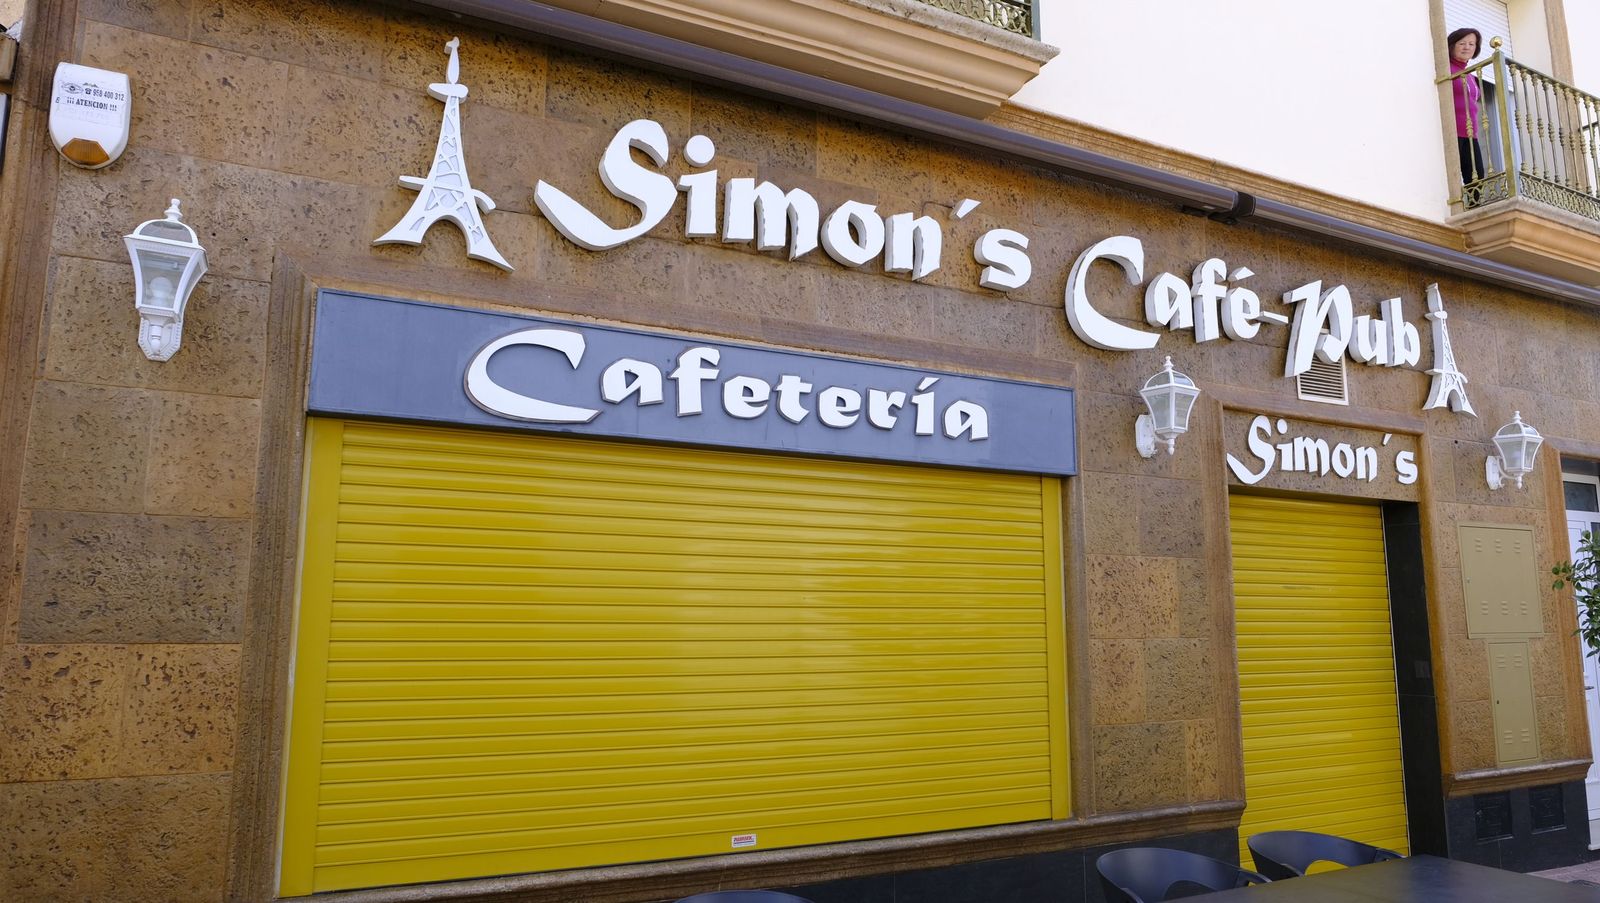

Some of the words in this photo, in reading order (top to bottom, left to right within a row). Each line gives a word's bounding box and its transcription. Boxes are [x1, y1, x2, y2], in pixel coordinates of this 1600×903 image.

[76, 98, 108, 110] ATENCION
[104, 91, 114, 100] 400
[115, 92, 125, 102] 312
[534, 119, 1032, 292] Simon's
[1065, 235, 1421, 377] Café-Pub
[463, 327, 990, 442] Cafetería
[1226, 415, 1418, 485] Simon's
